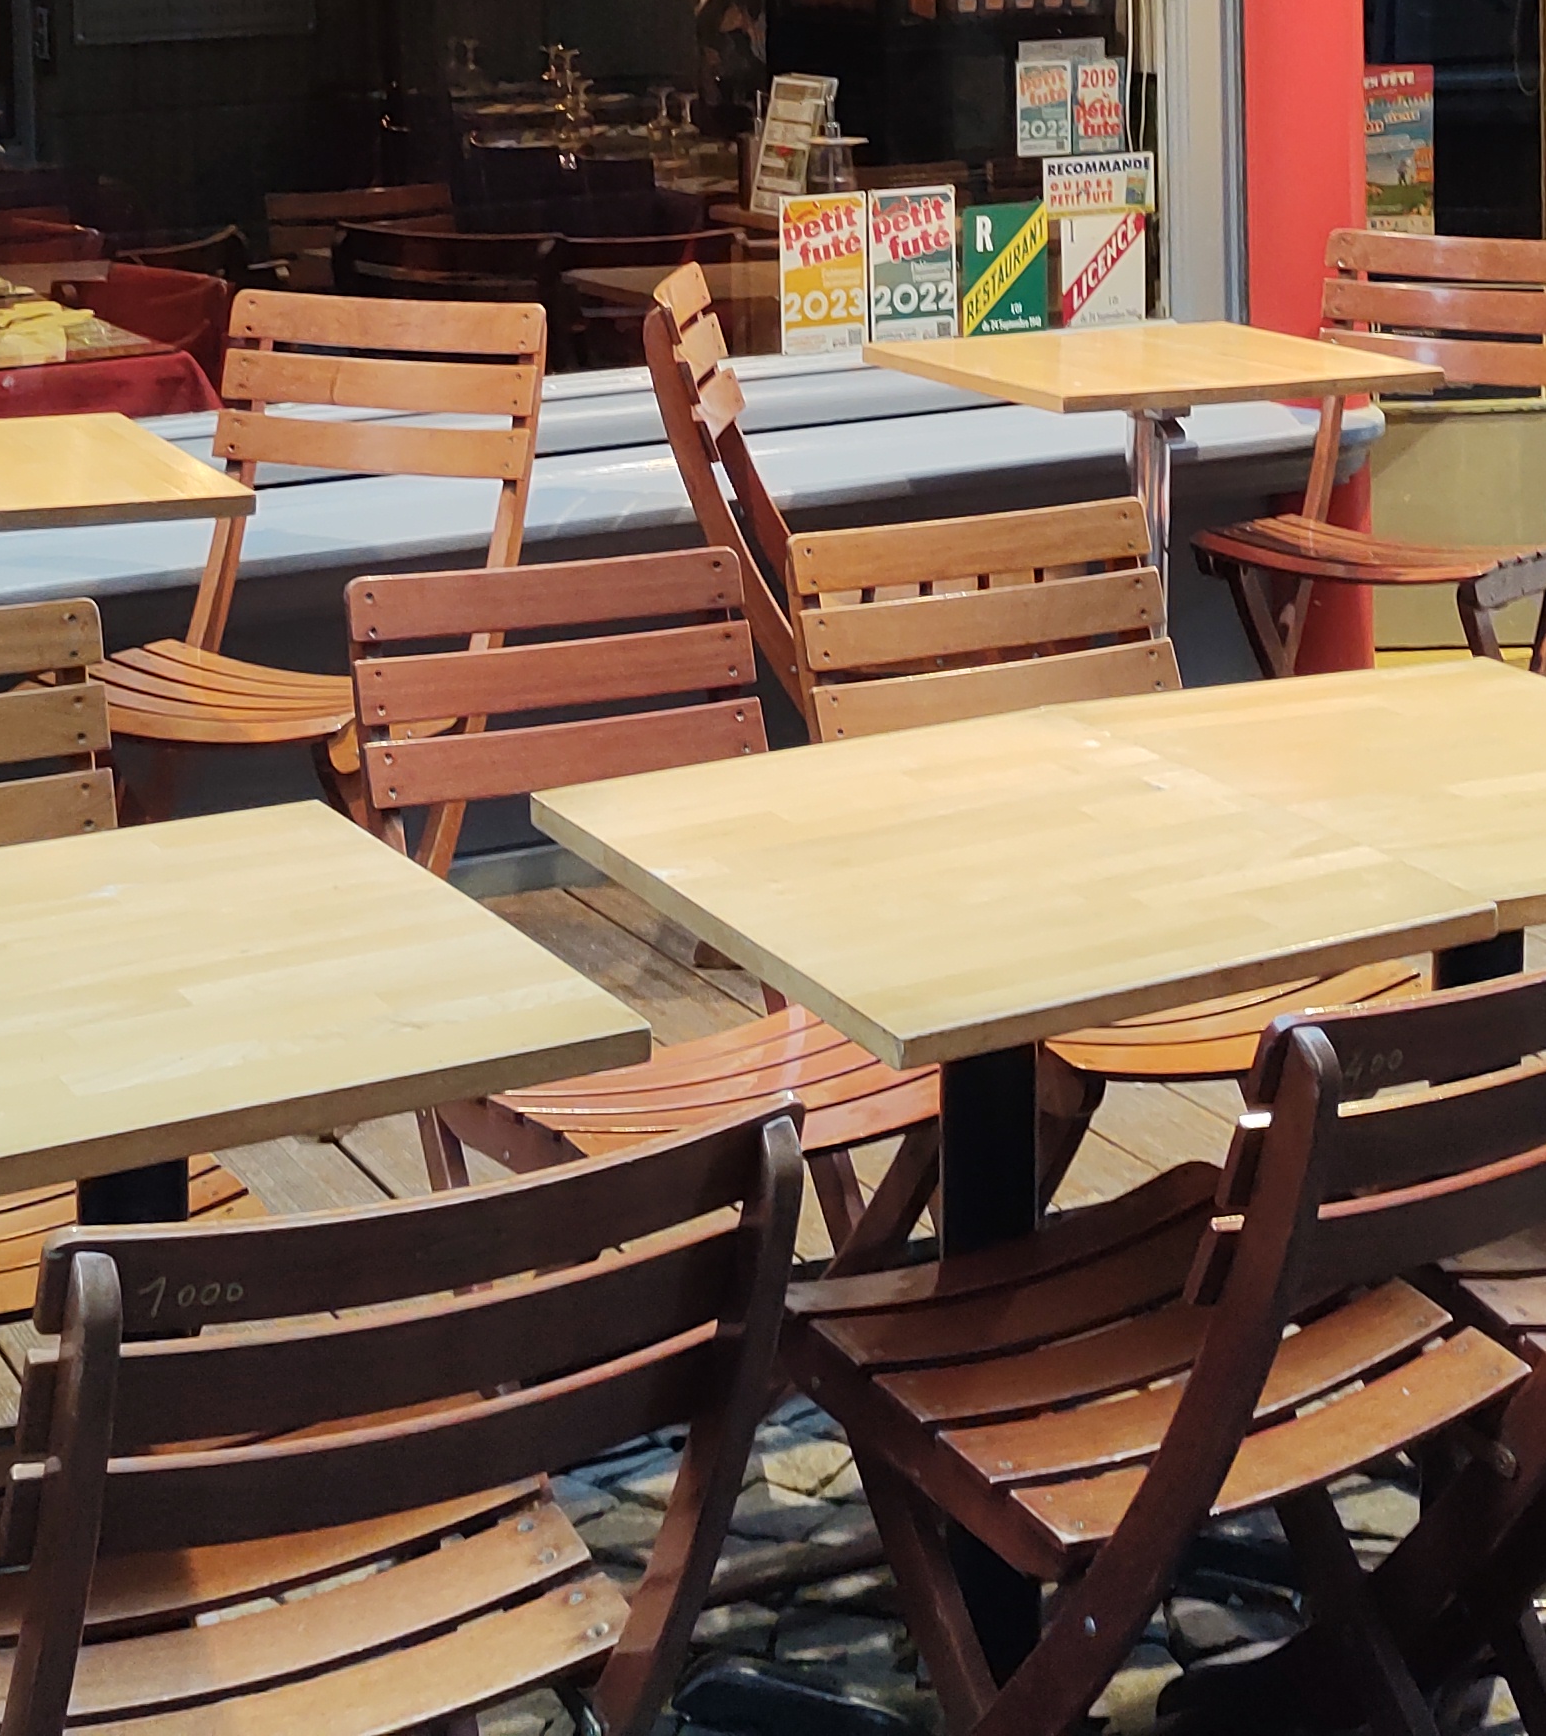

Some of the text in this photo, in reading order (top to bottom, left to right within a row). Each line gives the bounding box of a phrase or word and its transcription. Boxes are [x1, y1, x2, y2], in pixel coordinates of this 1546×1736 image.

[1080, 68, 1117, 88] 2019
[1020, 120, 1069, 139] 2022
[782, 203, 858, 252] petit
[872, 196, 946, 245] petit
[975, 215, 994, 253] R
[799, 231, 862, 268] futé
[888, 224, 951, 264] futé
[1072, 214, 1138, 311] LICENCE
[966, 215, 1045, 326] RESTAURANT
[784, 287, 865, 322] 2023
[874, 280, 954, 315] 2022
[139, 1276, 245, 1319] 1000
